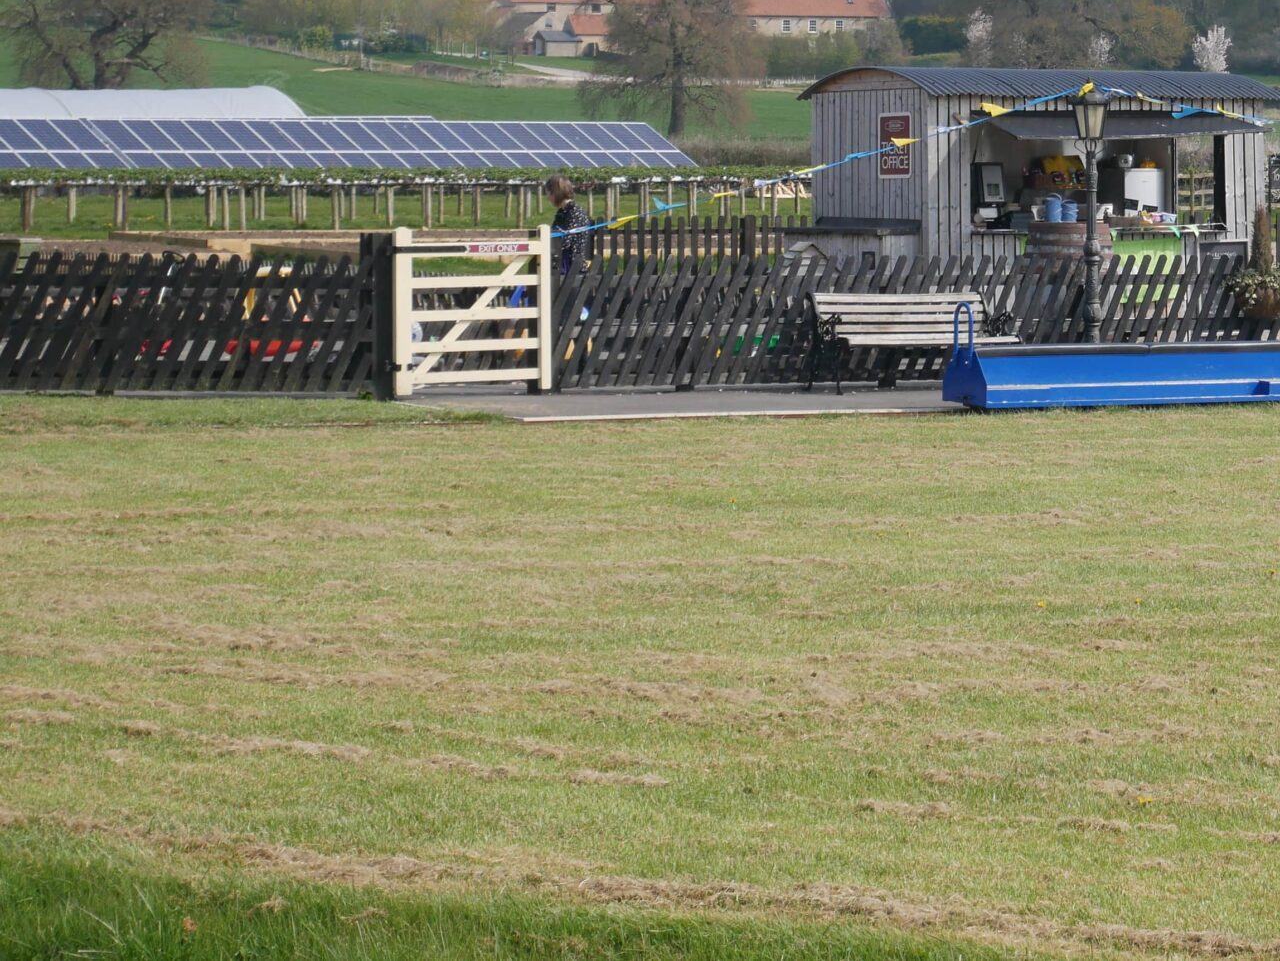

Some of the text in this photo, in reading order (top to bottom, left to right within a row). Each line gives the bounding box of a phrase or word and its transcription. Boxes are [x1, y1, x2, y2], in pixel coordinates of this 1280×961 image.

[881, 141, 908, 155] TICKET
[881, 155, 909, 169] OFFICE
[479, 243, 518, 253] EXIT ONLY
